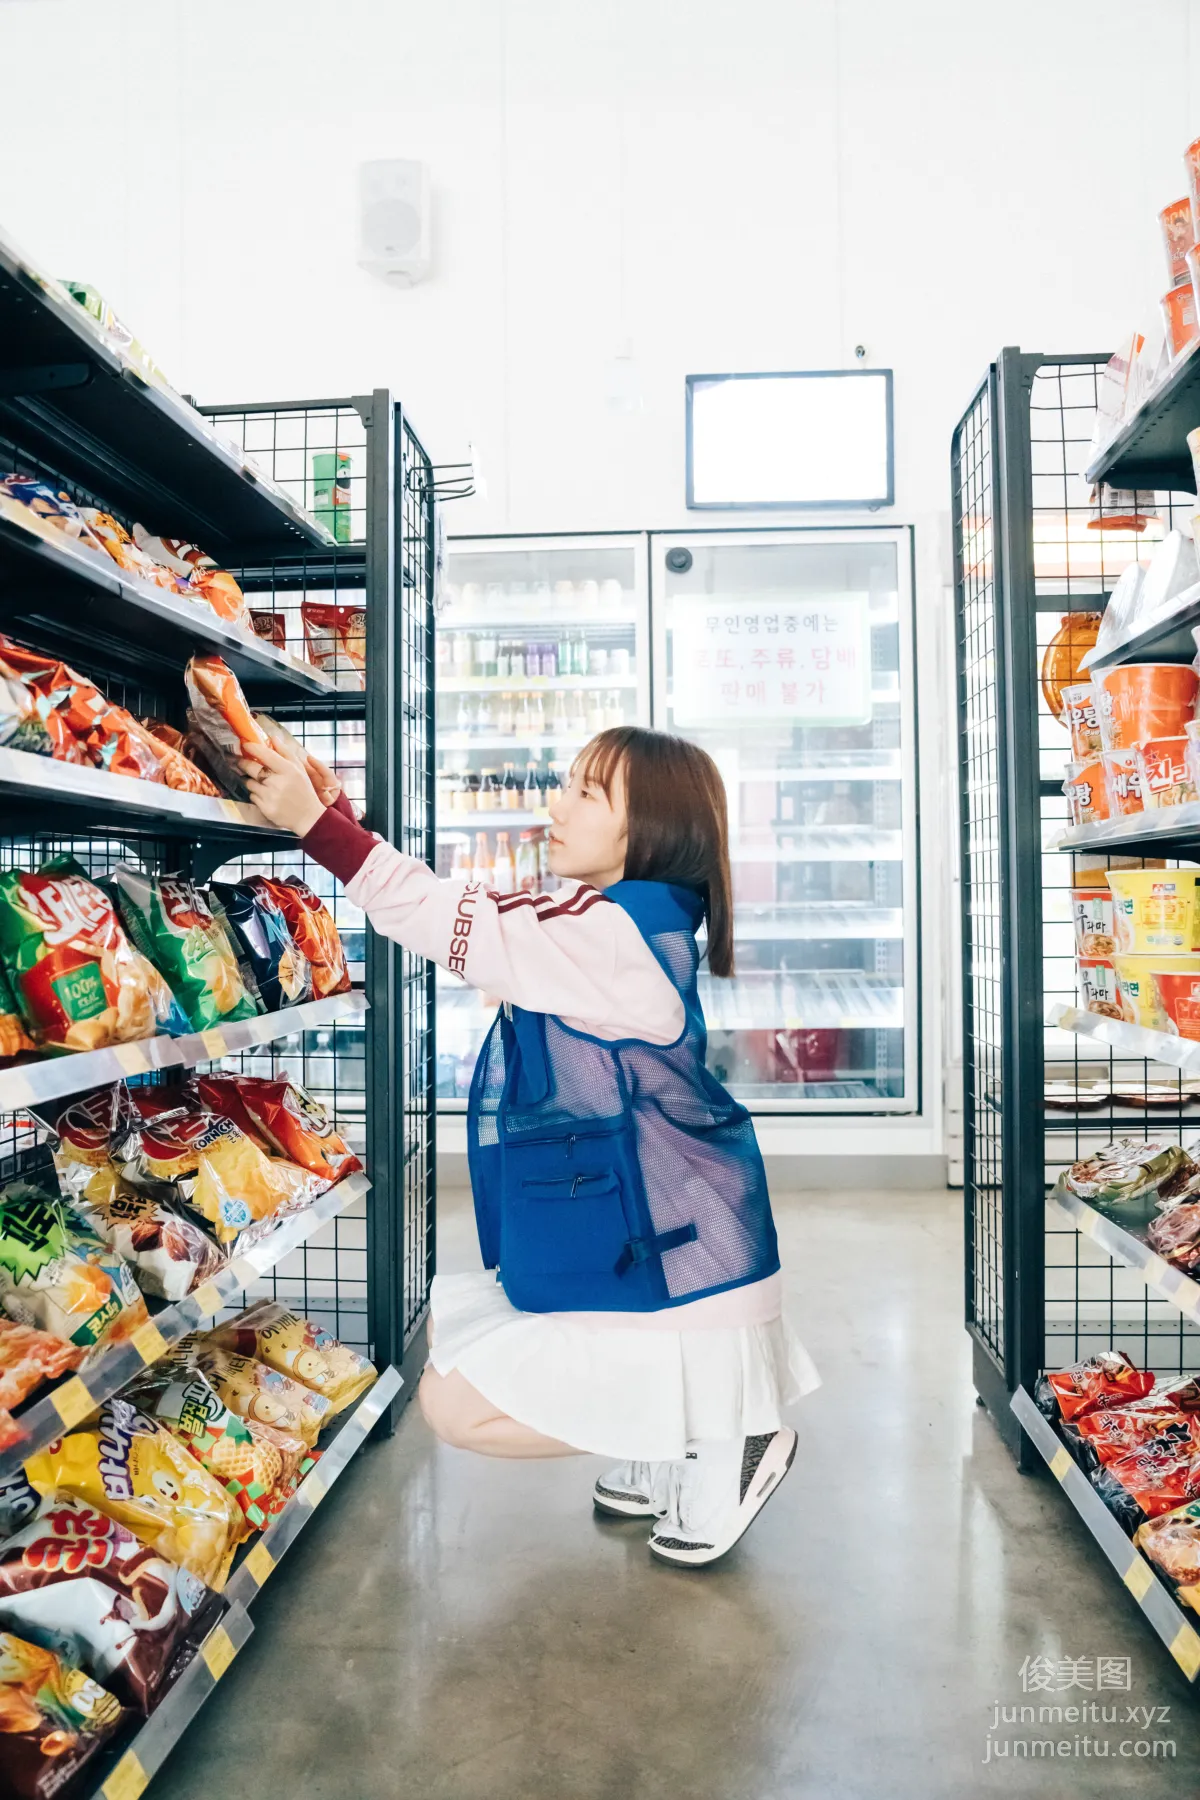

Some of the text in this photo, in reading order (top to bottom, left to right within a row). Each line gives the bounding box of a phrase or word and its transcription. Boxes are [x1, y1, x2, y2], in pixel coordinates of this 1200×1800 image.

[705, 614, 839, 635] 무인영업중에는
[811, 645, 857, 670] 담배
[720, 680, 827, 706] 판매 불가
[64, 976, 99, 998] 100%
[192, 1128, 220, 1151] CORN
